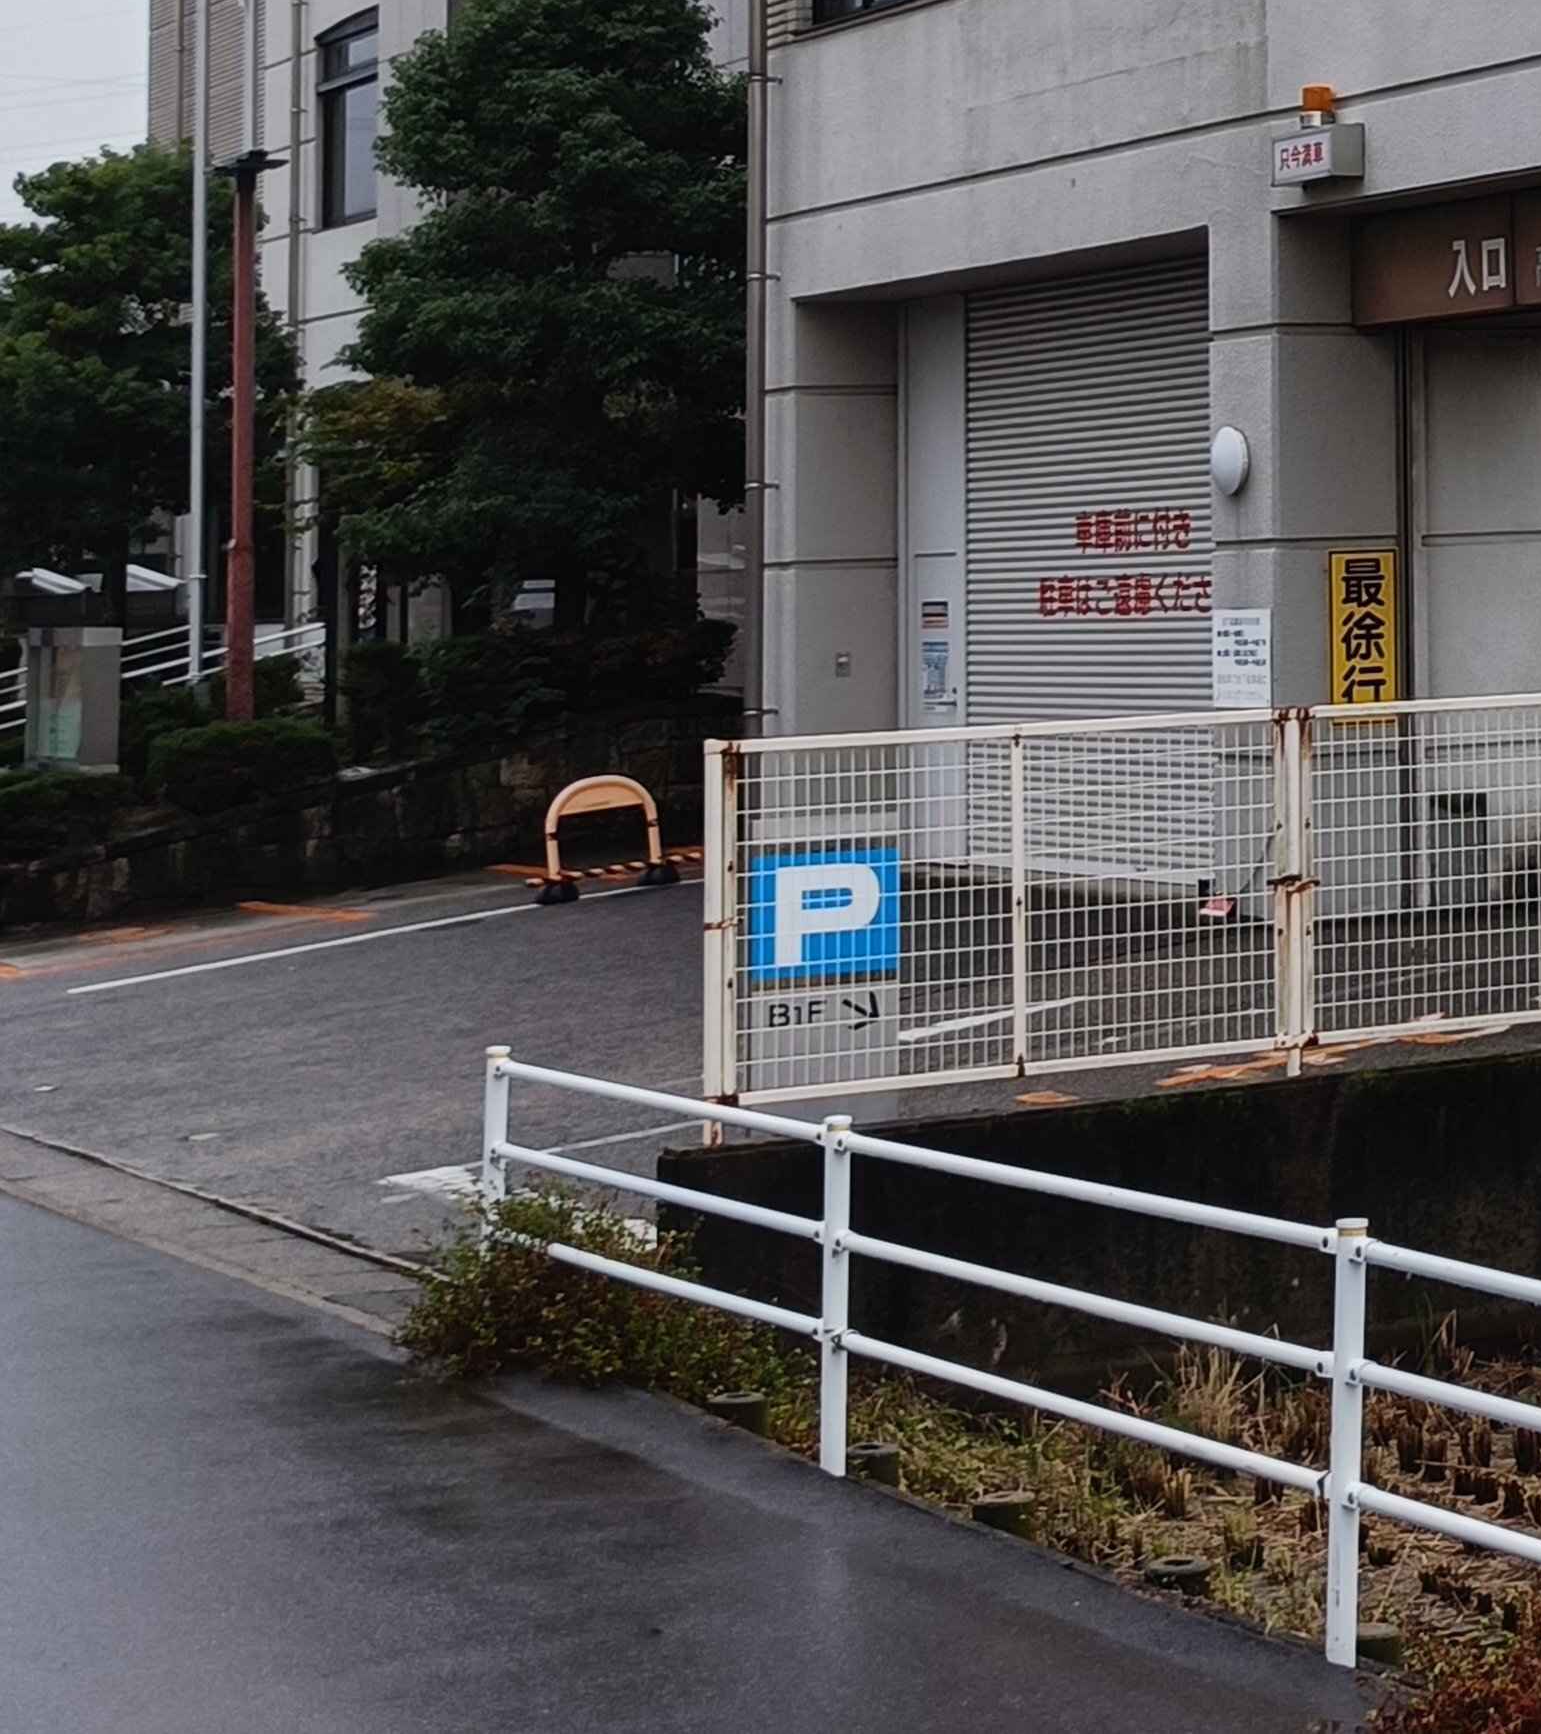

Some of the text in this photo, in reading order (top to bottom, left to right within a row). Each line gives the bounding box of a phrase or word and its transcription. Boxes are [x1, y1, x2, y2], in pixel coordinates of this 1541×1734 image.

[1448, 238, 1507, 297] 入口
[1341, 558, 1387, 703] 最徐行
[774, 863, 880, 967] P
